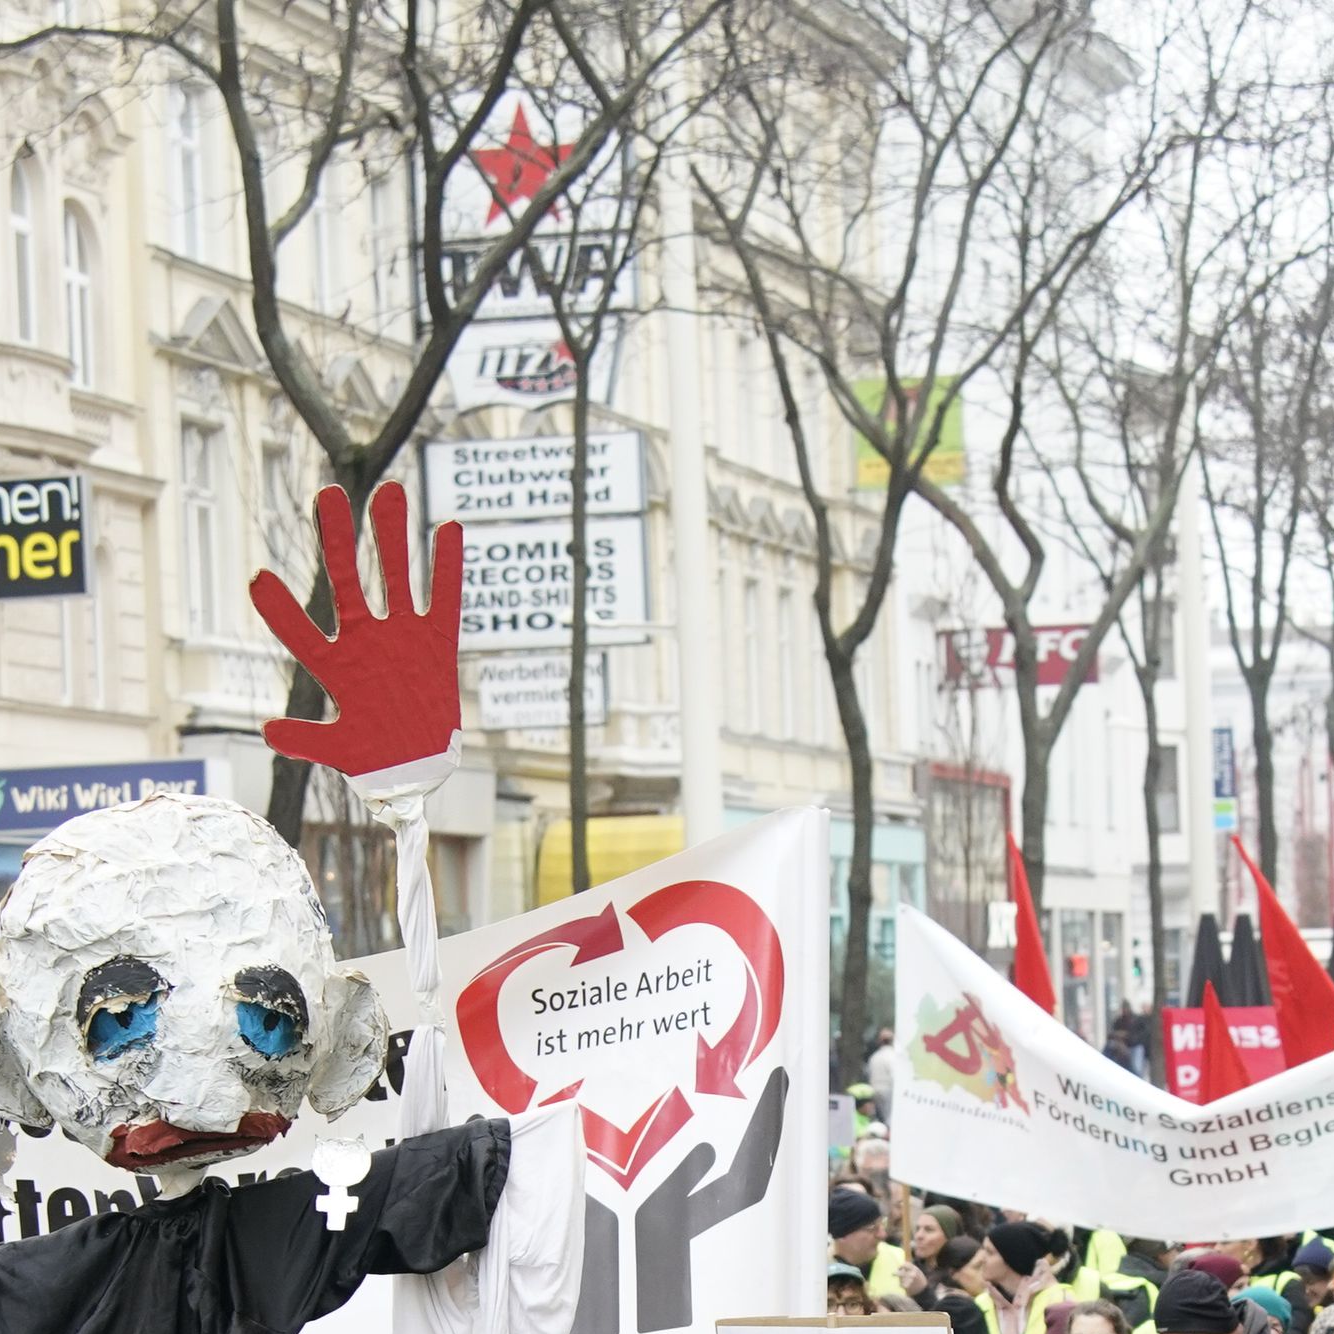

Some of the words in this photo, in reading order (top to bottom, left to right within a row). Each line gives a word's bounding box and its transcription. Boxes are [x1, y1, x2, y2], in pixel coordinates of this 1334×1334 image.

[456, 494, 514, 511] 2nd
[528, 487, 611, 508] Had
[461, 587, 617, 609] BAND-SHITS
[530, 975, 628, 1017] Soziale
[635, 958, 714, 998] Arbeit
[536, 1029, 568, 1056] ist
[576, 1017, 645, 1052] mehr
[652, 1002, 712, 1038] wert
[1056, 1073, 1149, 1125] Wiener
[1033, 1091, 1168, 1162] Förderung
[1179, 1133, 1239, 1161] und
[1169, 1162, 1269, 1187] GmbH
